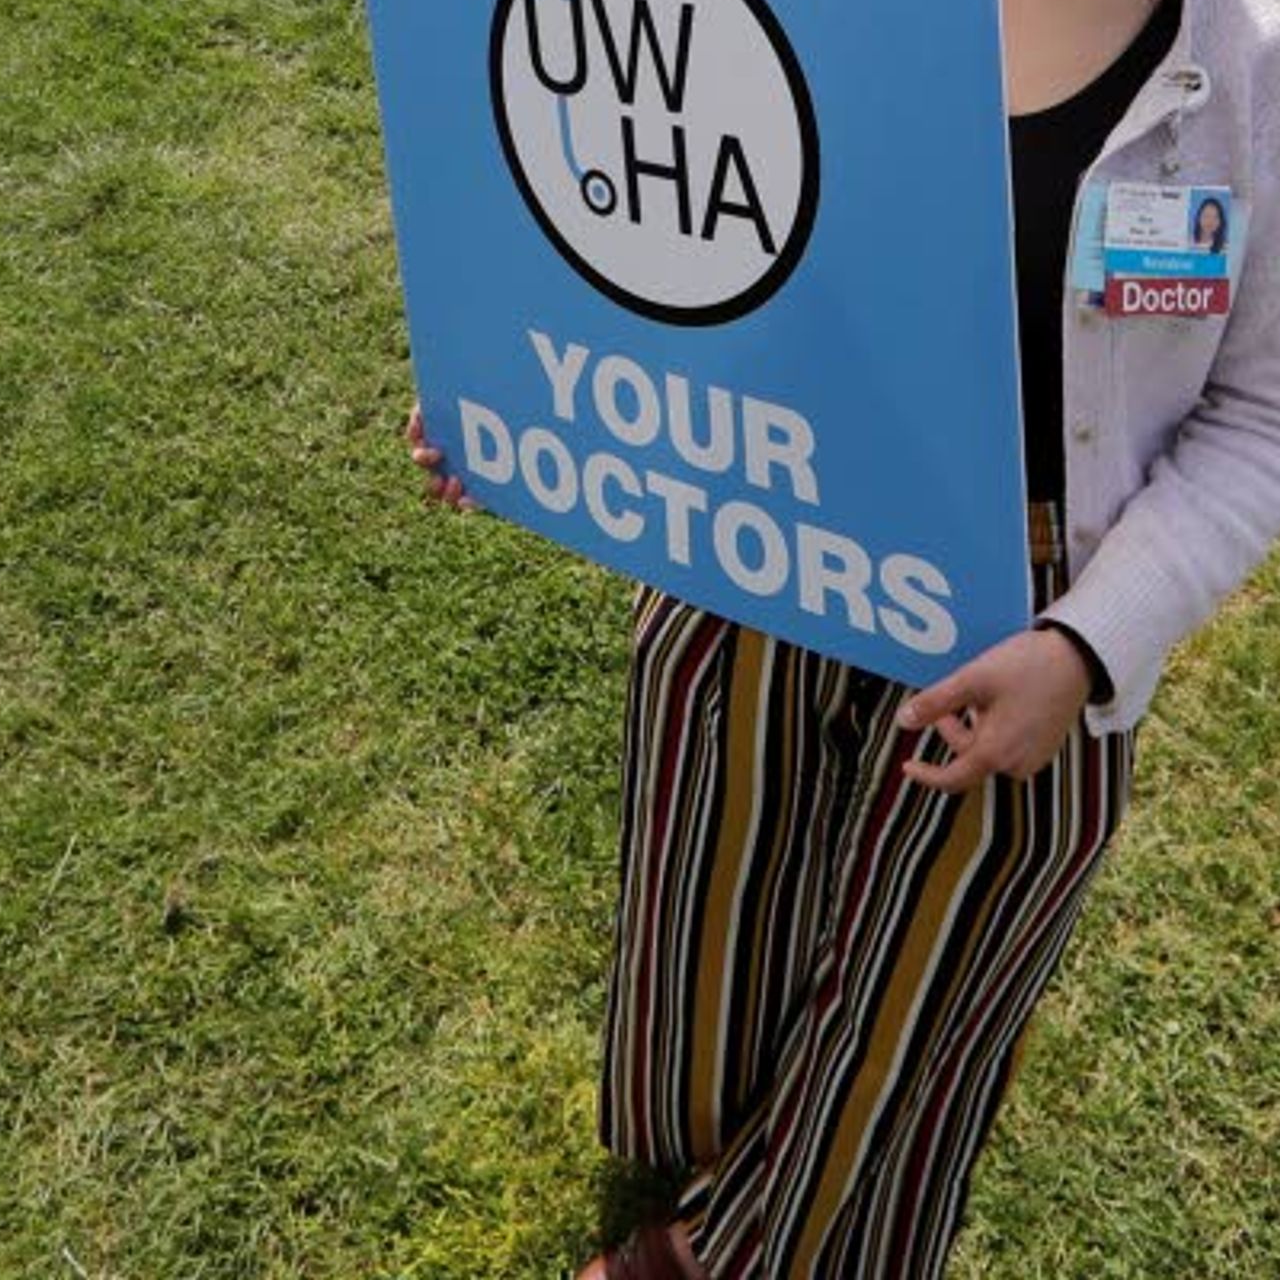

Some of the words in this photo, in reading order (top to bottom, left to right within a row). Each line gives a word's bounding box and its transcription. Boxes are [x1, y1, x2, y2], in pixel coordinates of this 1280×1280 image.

[621, 116, 777, 255] HA
[1123, 282, 1214, 312] Doctor
[527, 329, 820, 506] YOUR
[458, 398, 958, 655] DOCTORS
